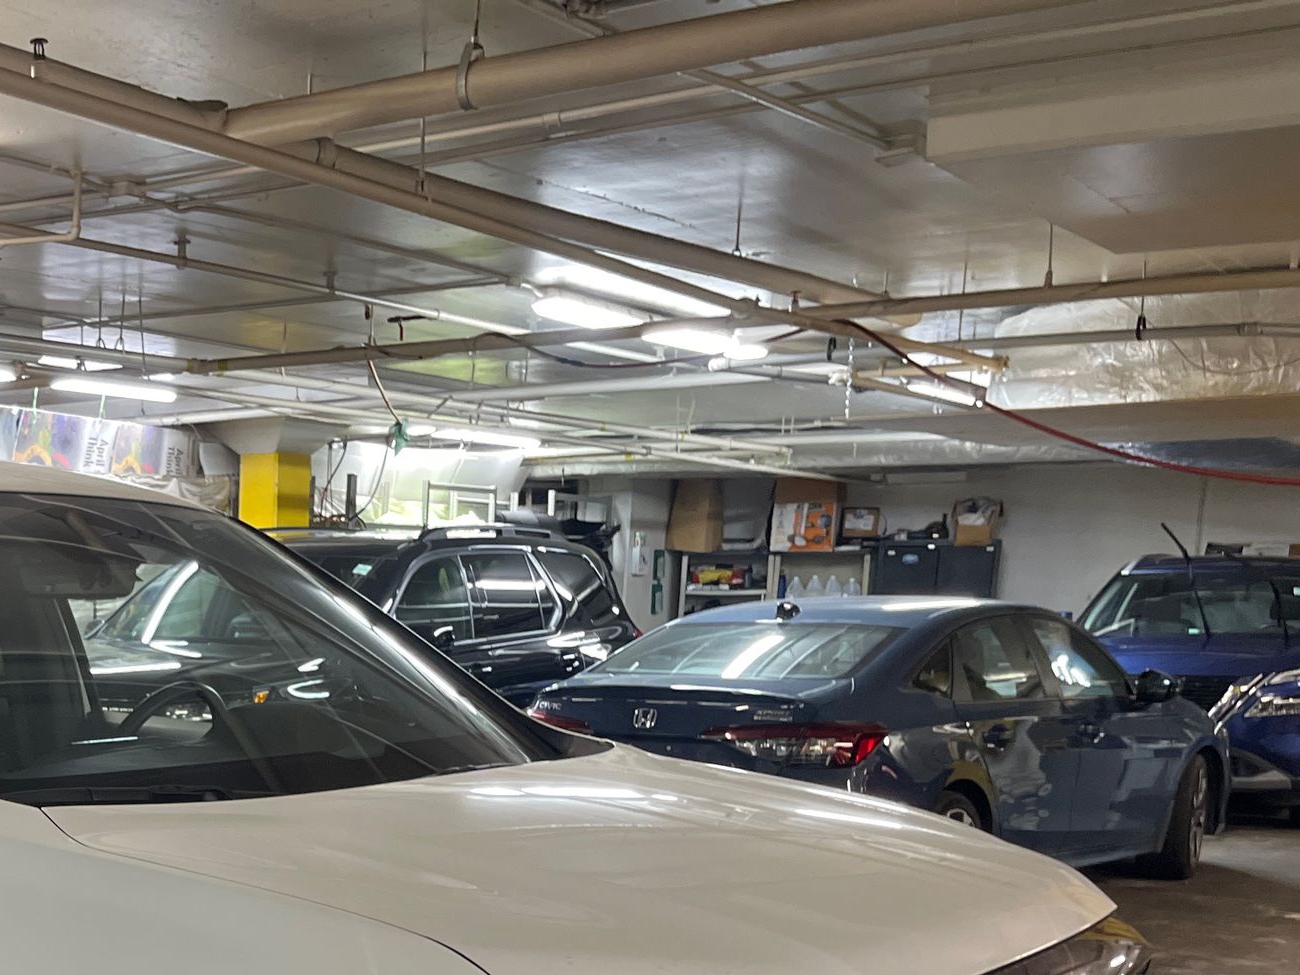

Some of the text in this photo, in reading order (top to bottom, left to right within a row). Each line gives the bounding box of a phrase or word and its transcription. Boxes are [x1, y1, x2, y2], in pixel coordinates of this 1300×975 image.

[83, 436, 100, 468] Think
[95, 439, 109, 467] April
[174, 448, 184, 475] April
[539, 701, 562, 710] CIVIC
